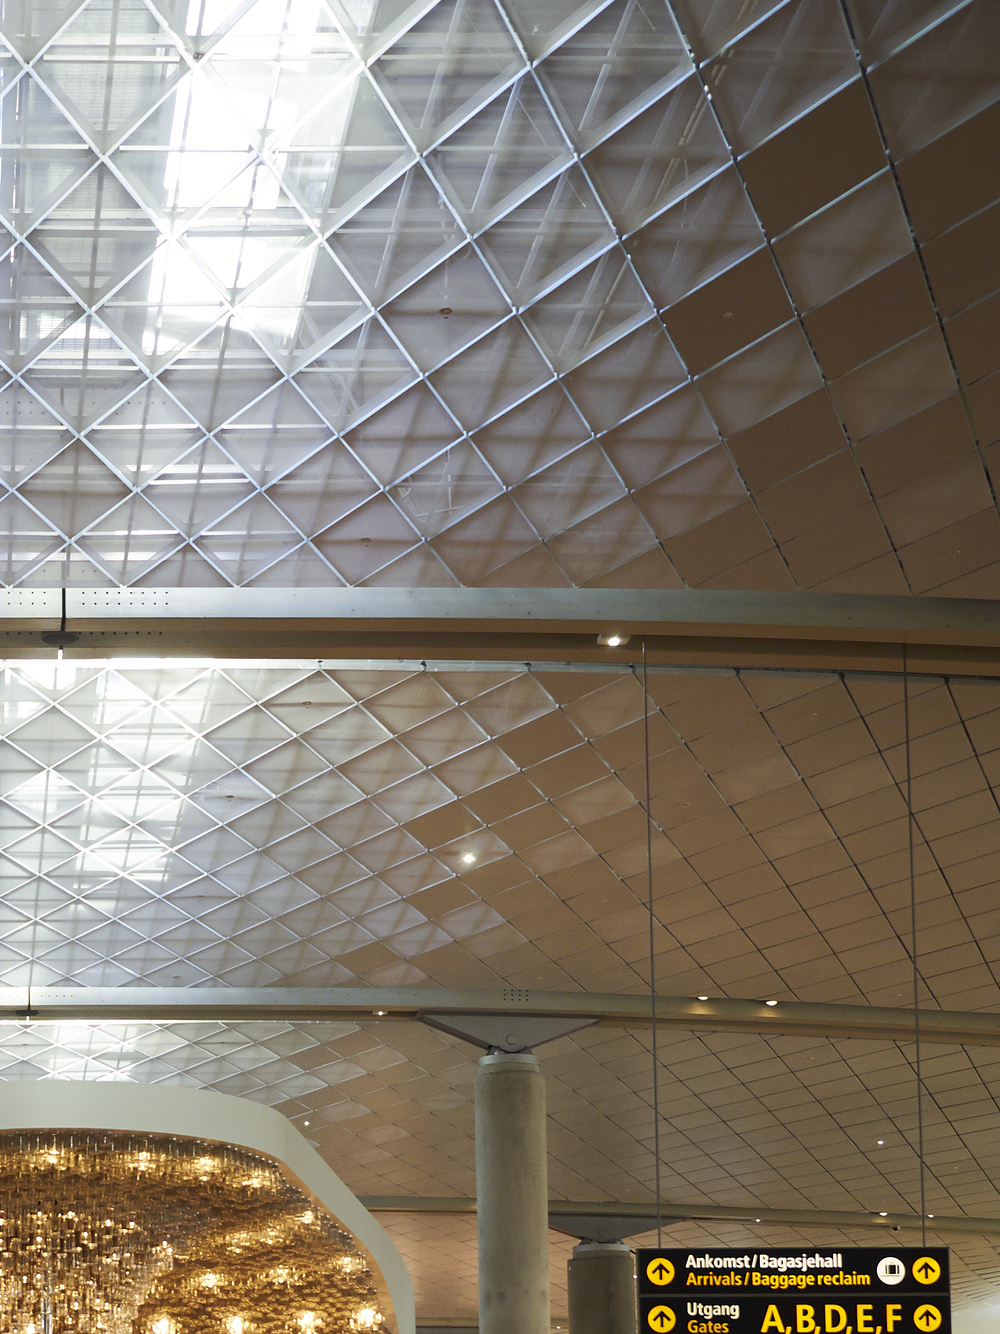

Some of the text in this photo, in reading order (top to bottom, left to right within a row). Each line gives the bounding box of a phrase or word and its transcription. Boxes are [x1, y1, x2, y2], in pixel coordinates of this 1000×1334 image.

[685, 1254, 751, 1269] Ankomst
[759, 1253, 843, 1272] Bagasjehall
[686, 1271, 743, 1286] Arrivals
[752, 1271, 816, 1290] Baggage
[817, 1270, 871, 1286] reclaim
[686, 1302, 740, 1320] Utgang
[687, 1319, 729, 1334] Gates
